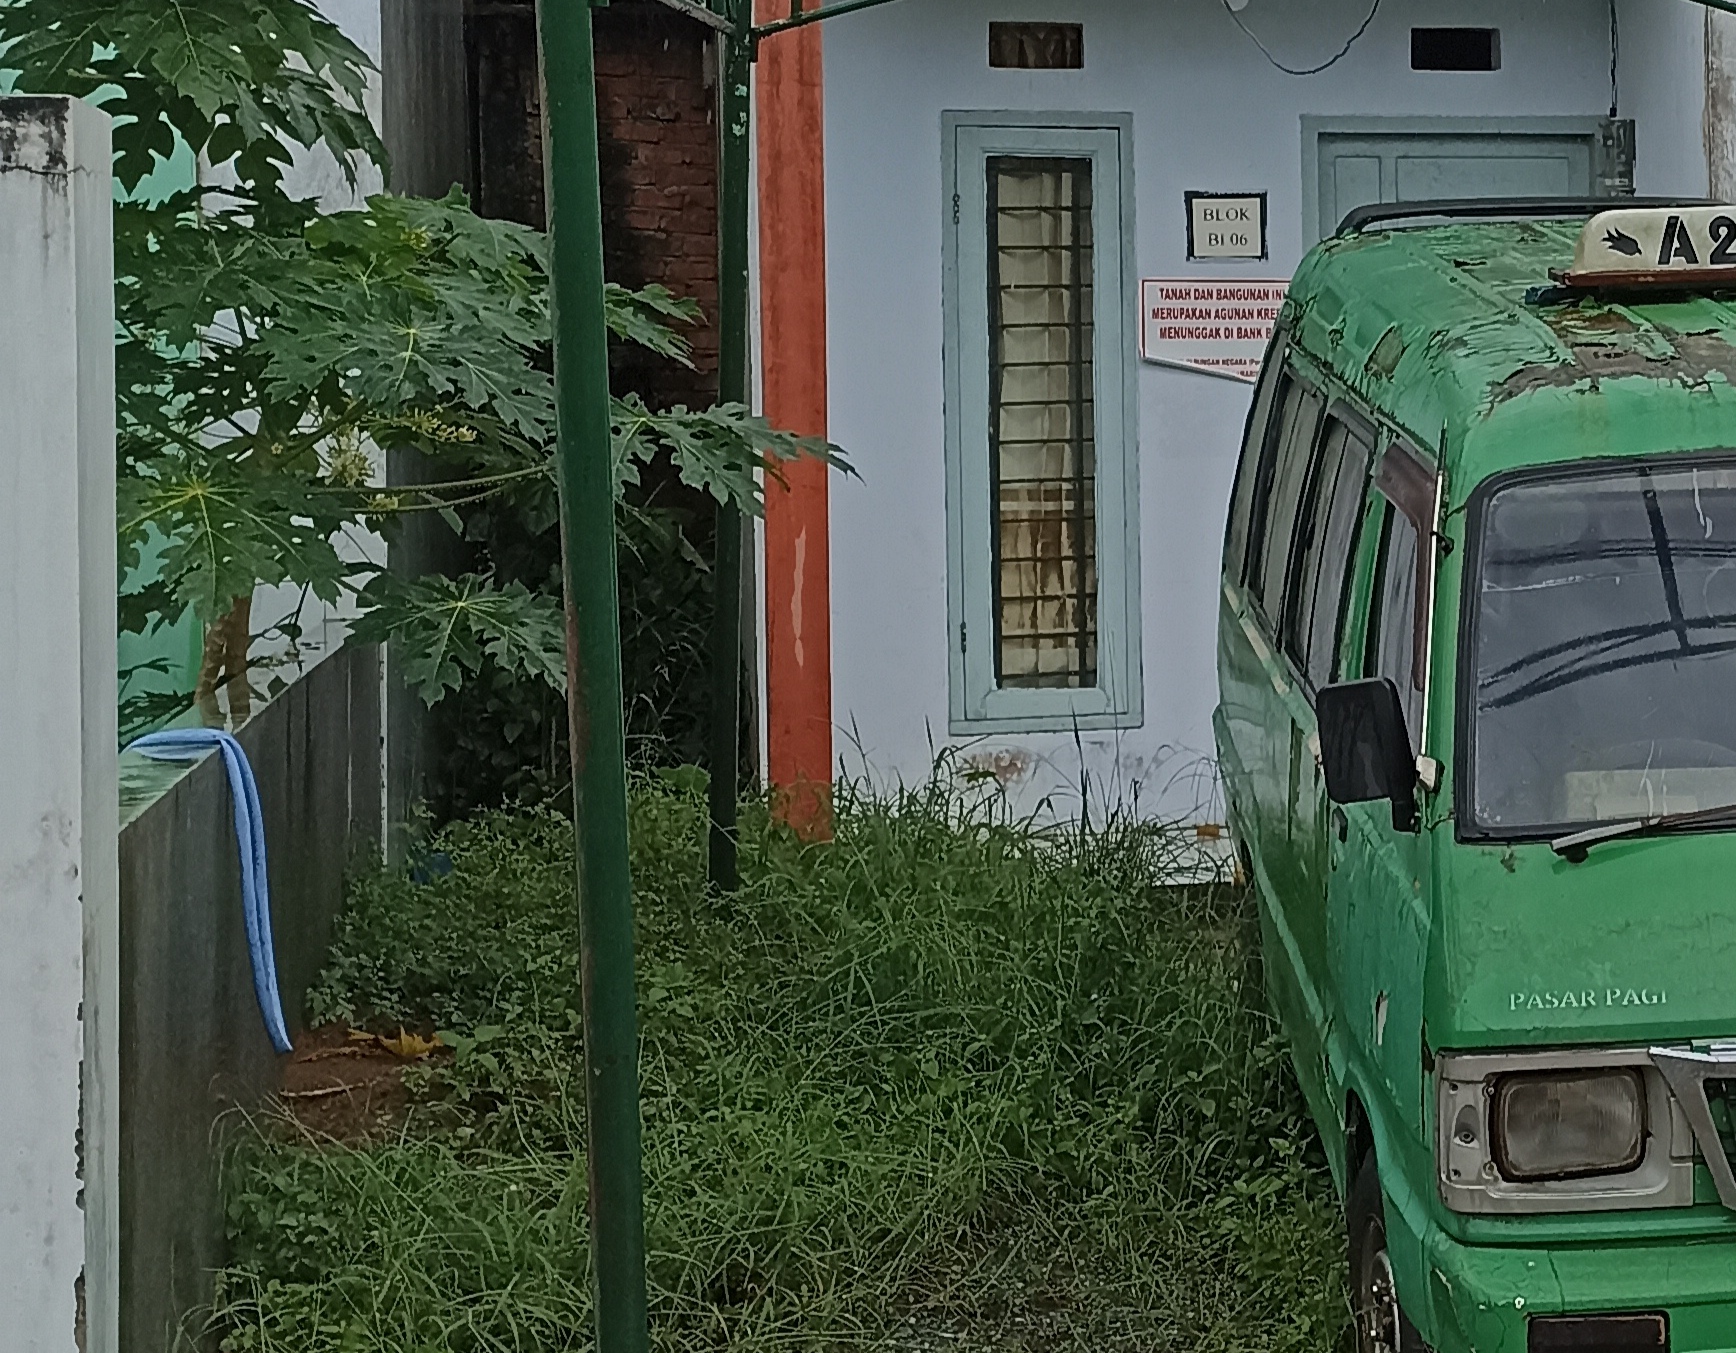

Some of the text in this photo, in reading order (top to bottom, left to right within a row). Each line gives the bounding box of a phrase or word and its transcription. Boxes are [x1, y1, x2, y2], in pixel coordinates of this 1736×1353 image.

[1203, 208, 1251, 222] BLOK
[1229, 232, 1248, 246] 06
[1657, 215, 1700, 265] A
[1158, 287, 1193, 302] TANAH
[1193, 287, 1215, 301] DAN
[1215, 287, 1271, 301] BANGUNAN
[1151, 307, 1213, 321] MERUPAKAN
[1213, 307, 1255, 321] AGUNAN
[1159, 326, 1222, 340] MENUNGGAK
[1223, 327, 1235, 340] DI
[1236, 326, 1264, 340] BANK
[1509, 987, 1667, 1011] PASAR PAGI
